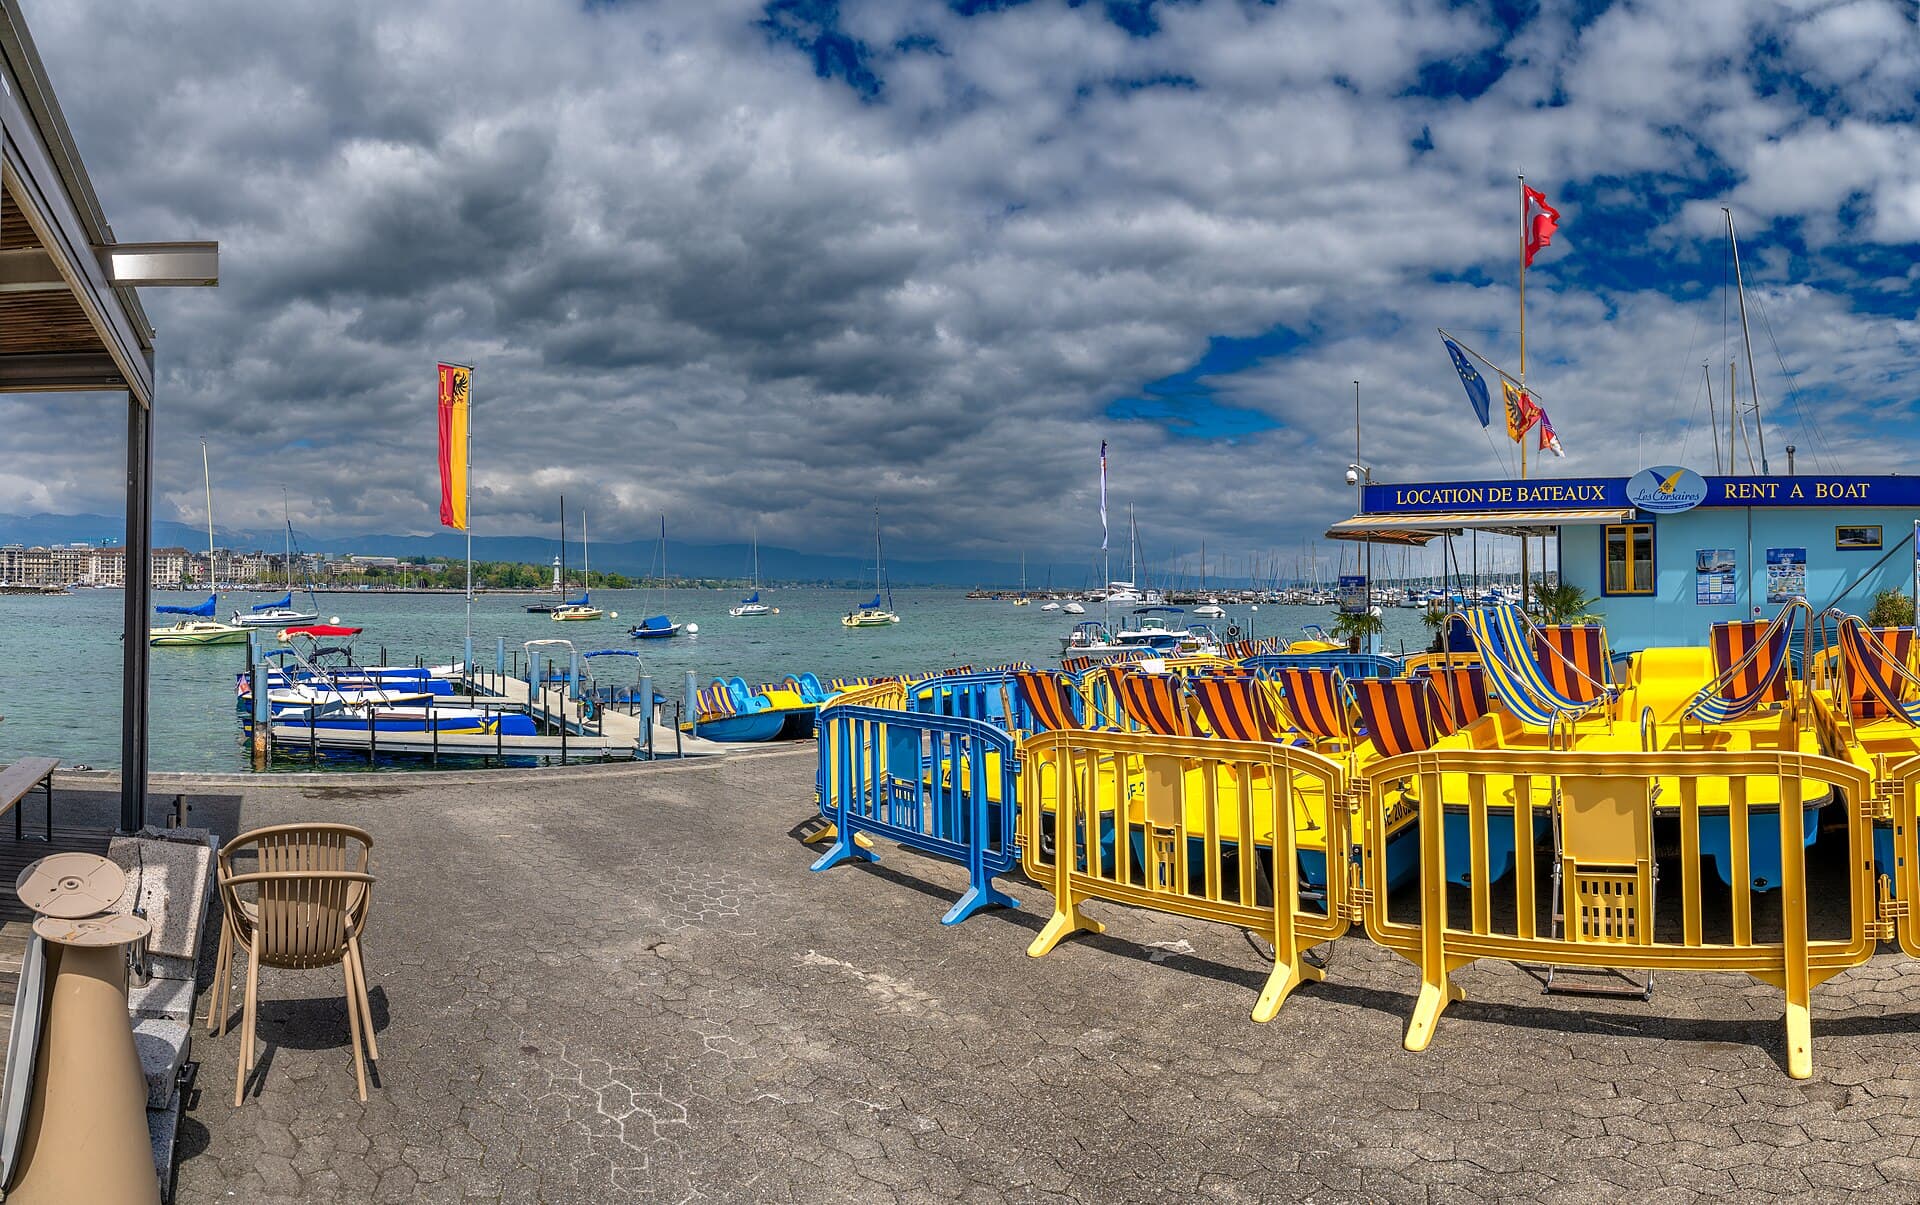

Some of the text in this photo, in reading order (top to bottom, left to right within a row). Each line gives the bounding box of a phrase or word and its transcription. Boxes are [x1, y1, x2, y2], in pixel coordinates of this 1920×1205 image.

[1396, 486, 1605, 505] LOCATION DE BATEAUX
[1633, 487, 1700, 501] Les Corsaires
[1724, 483, 1870, 498] RENT A BOAT
